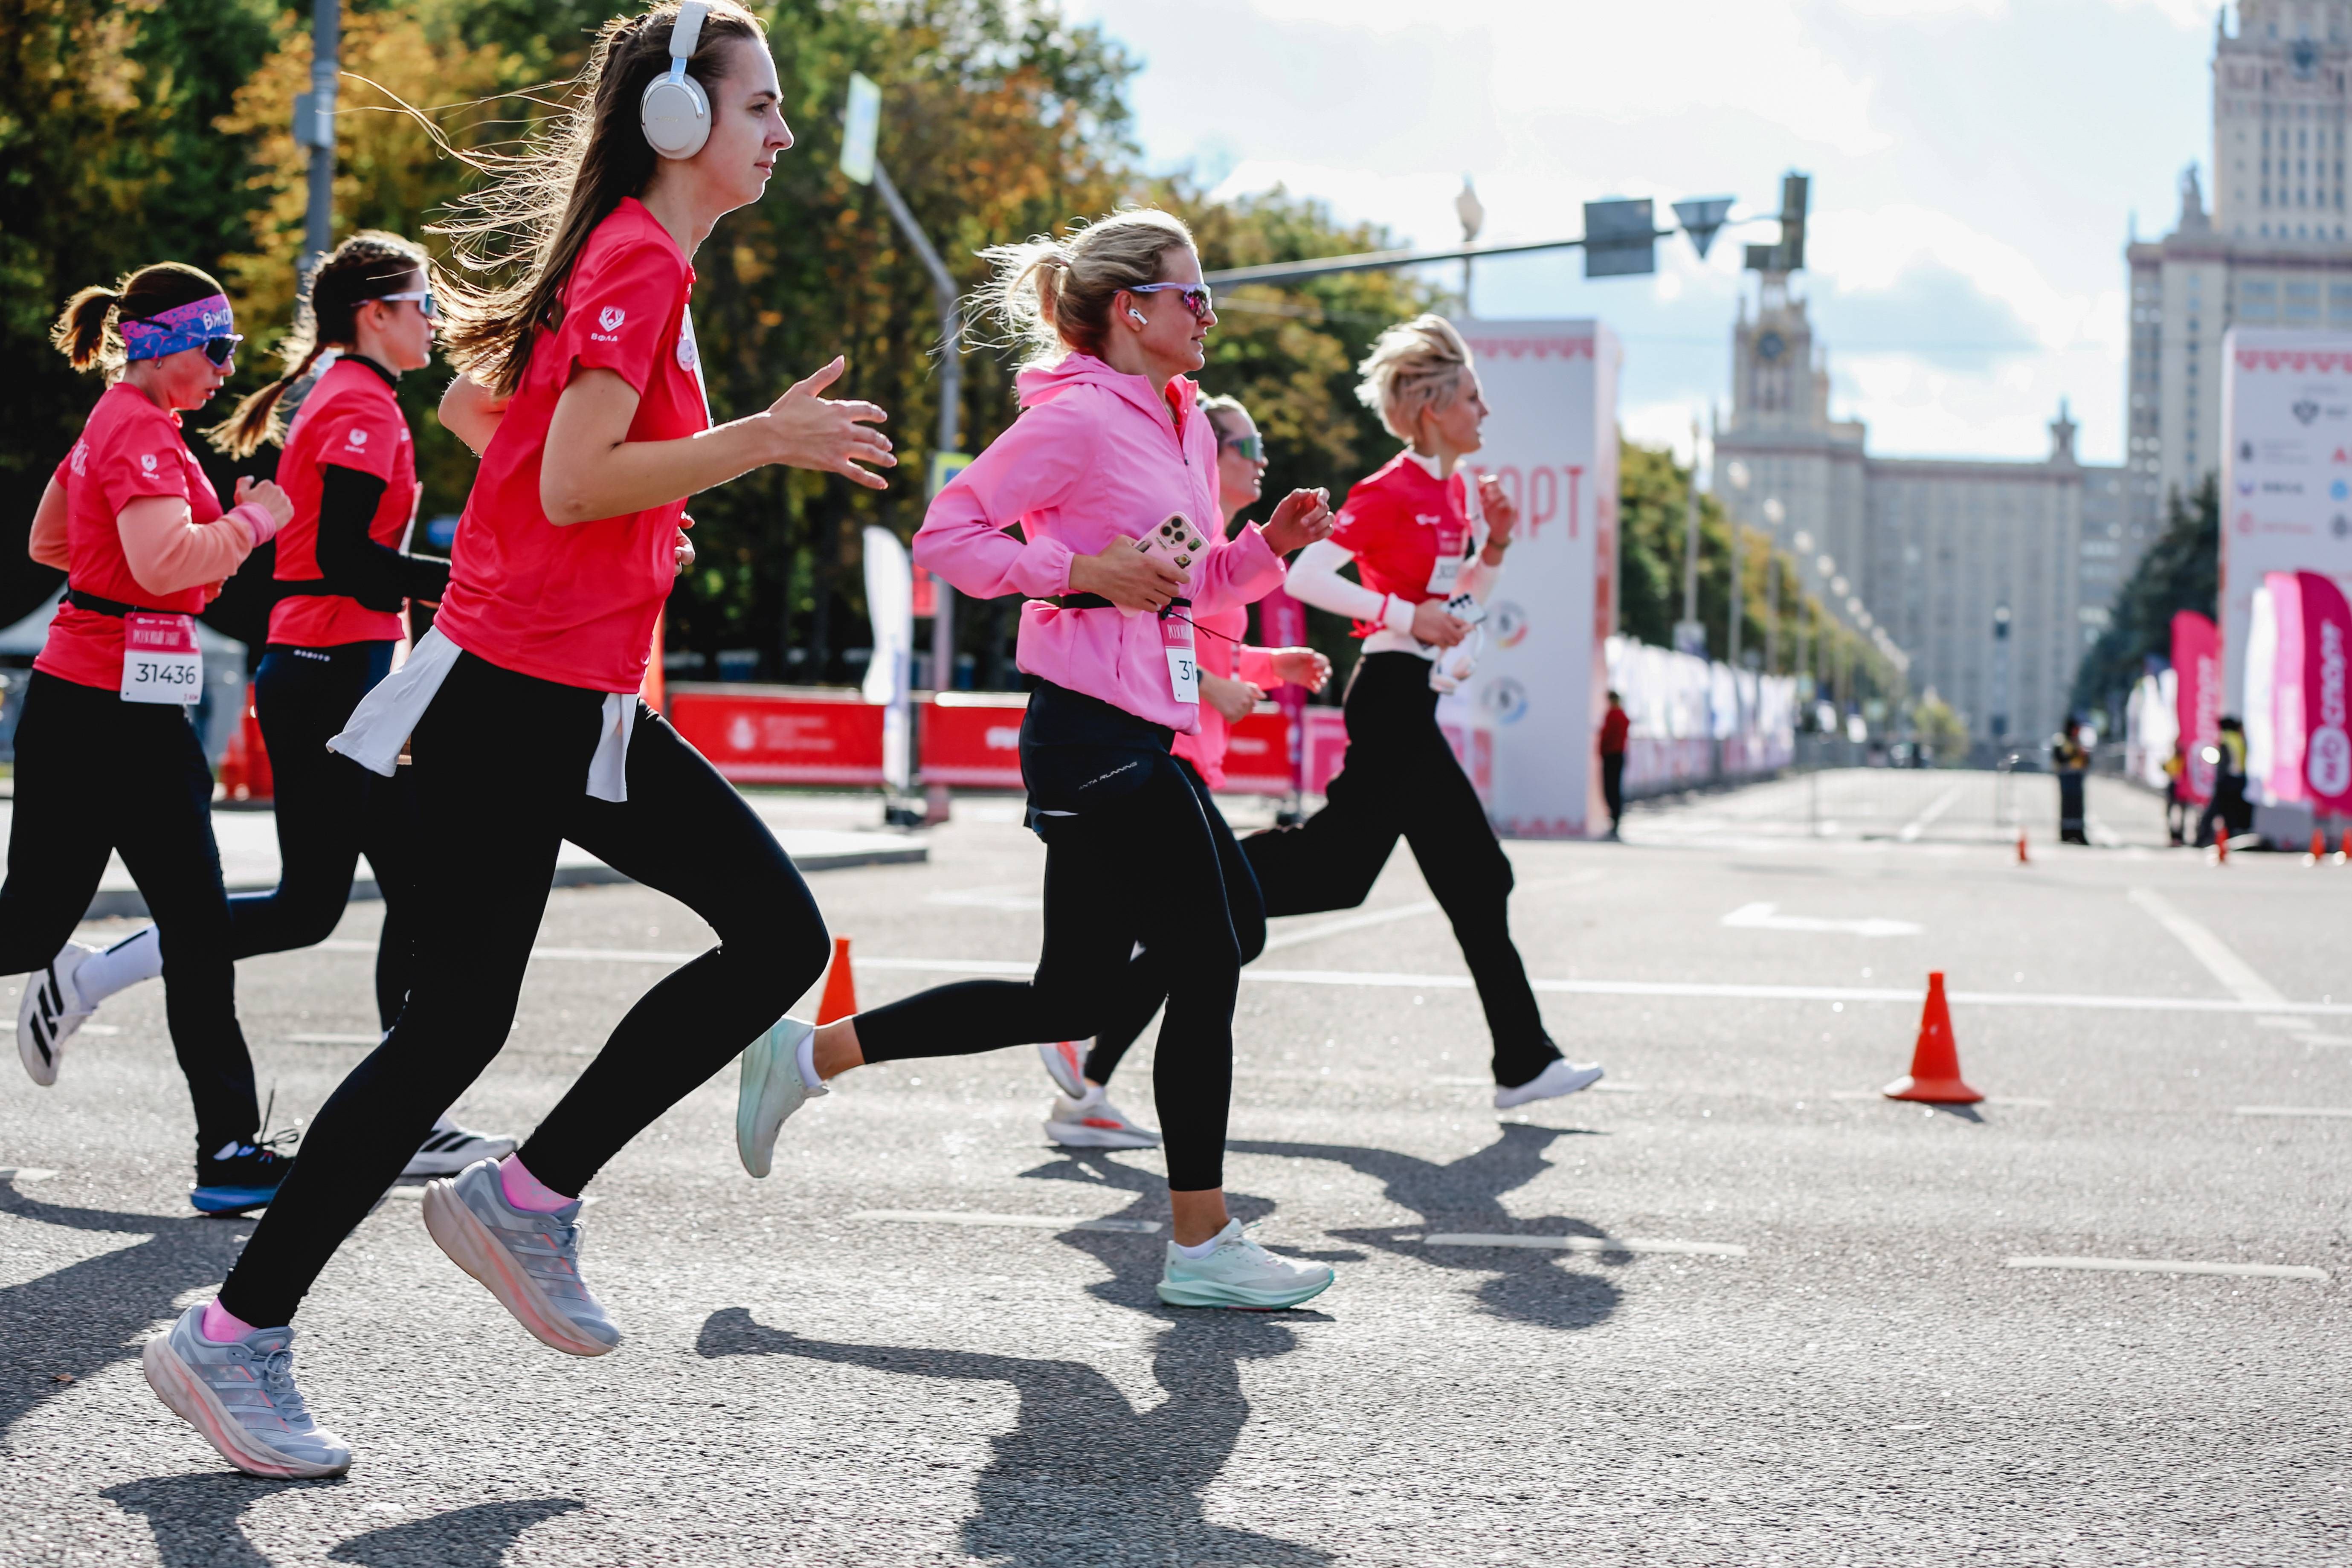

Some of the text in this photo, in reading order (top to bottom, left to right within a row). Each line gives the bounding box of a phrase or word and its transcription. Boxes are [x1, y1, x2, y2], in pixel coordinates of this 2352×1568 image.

[1470, 465, 1585, 538] ТАРТ
[135, 663, 196, 684] 31436
[1178, 660, 1196, 681] 31
[1099, 761, 1137, 781] RUNNING
